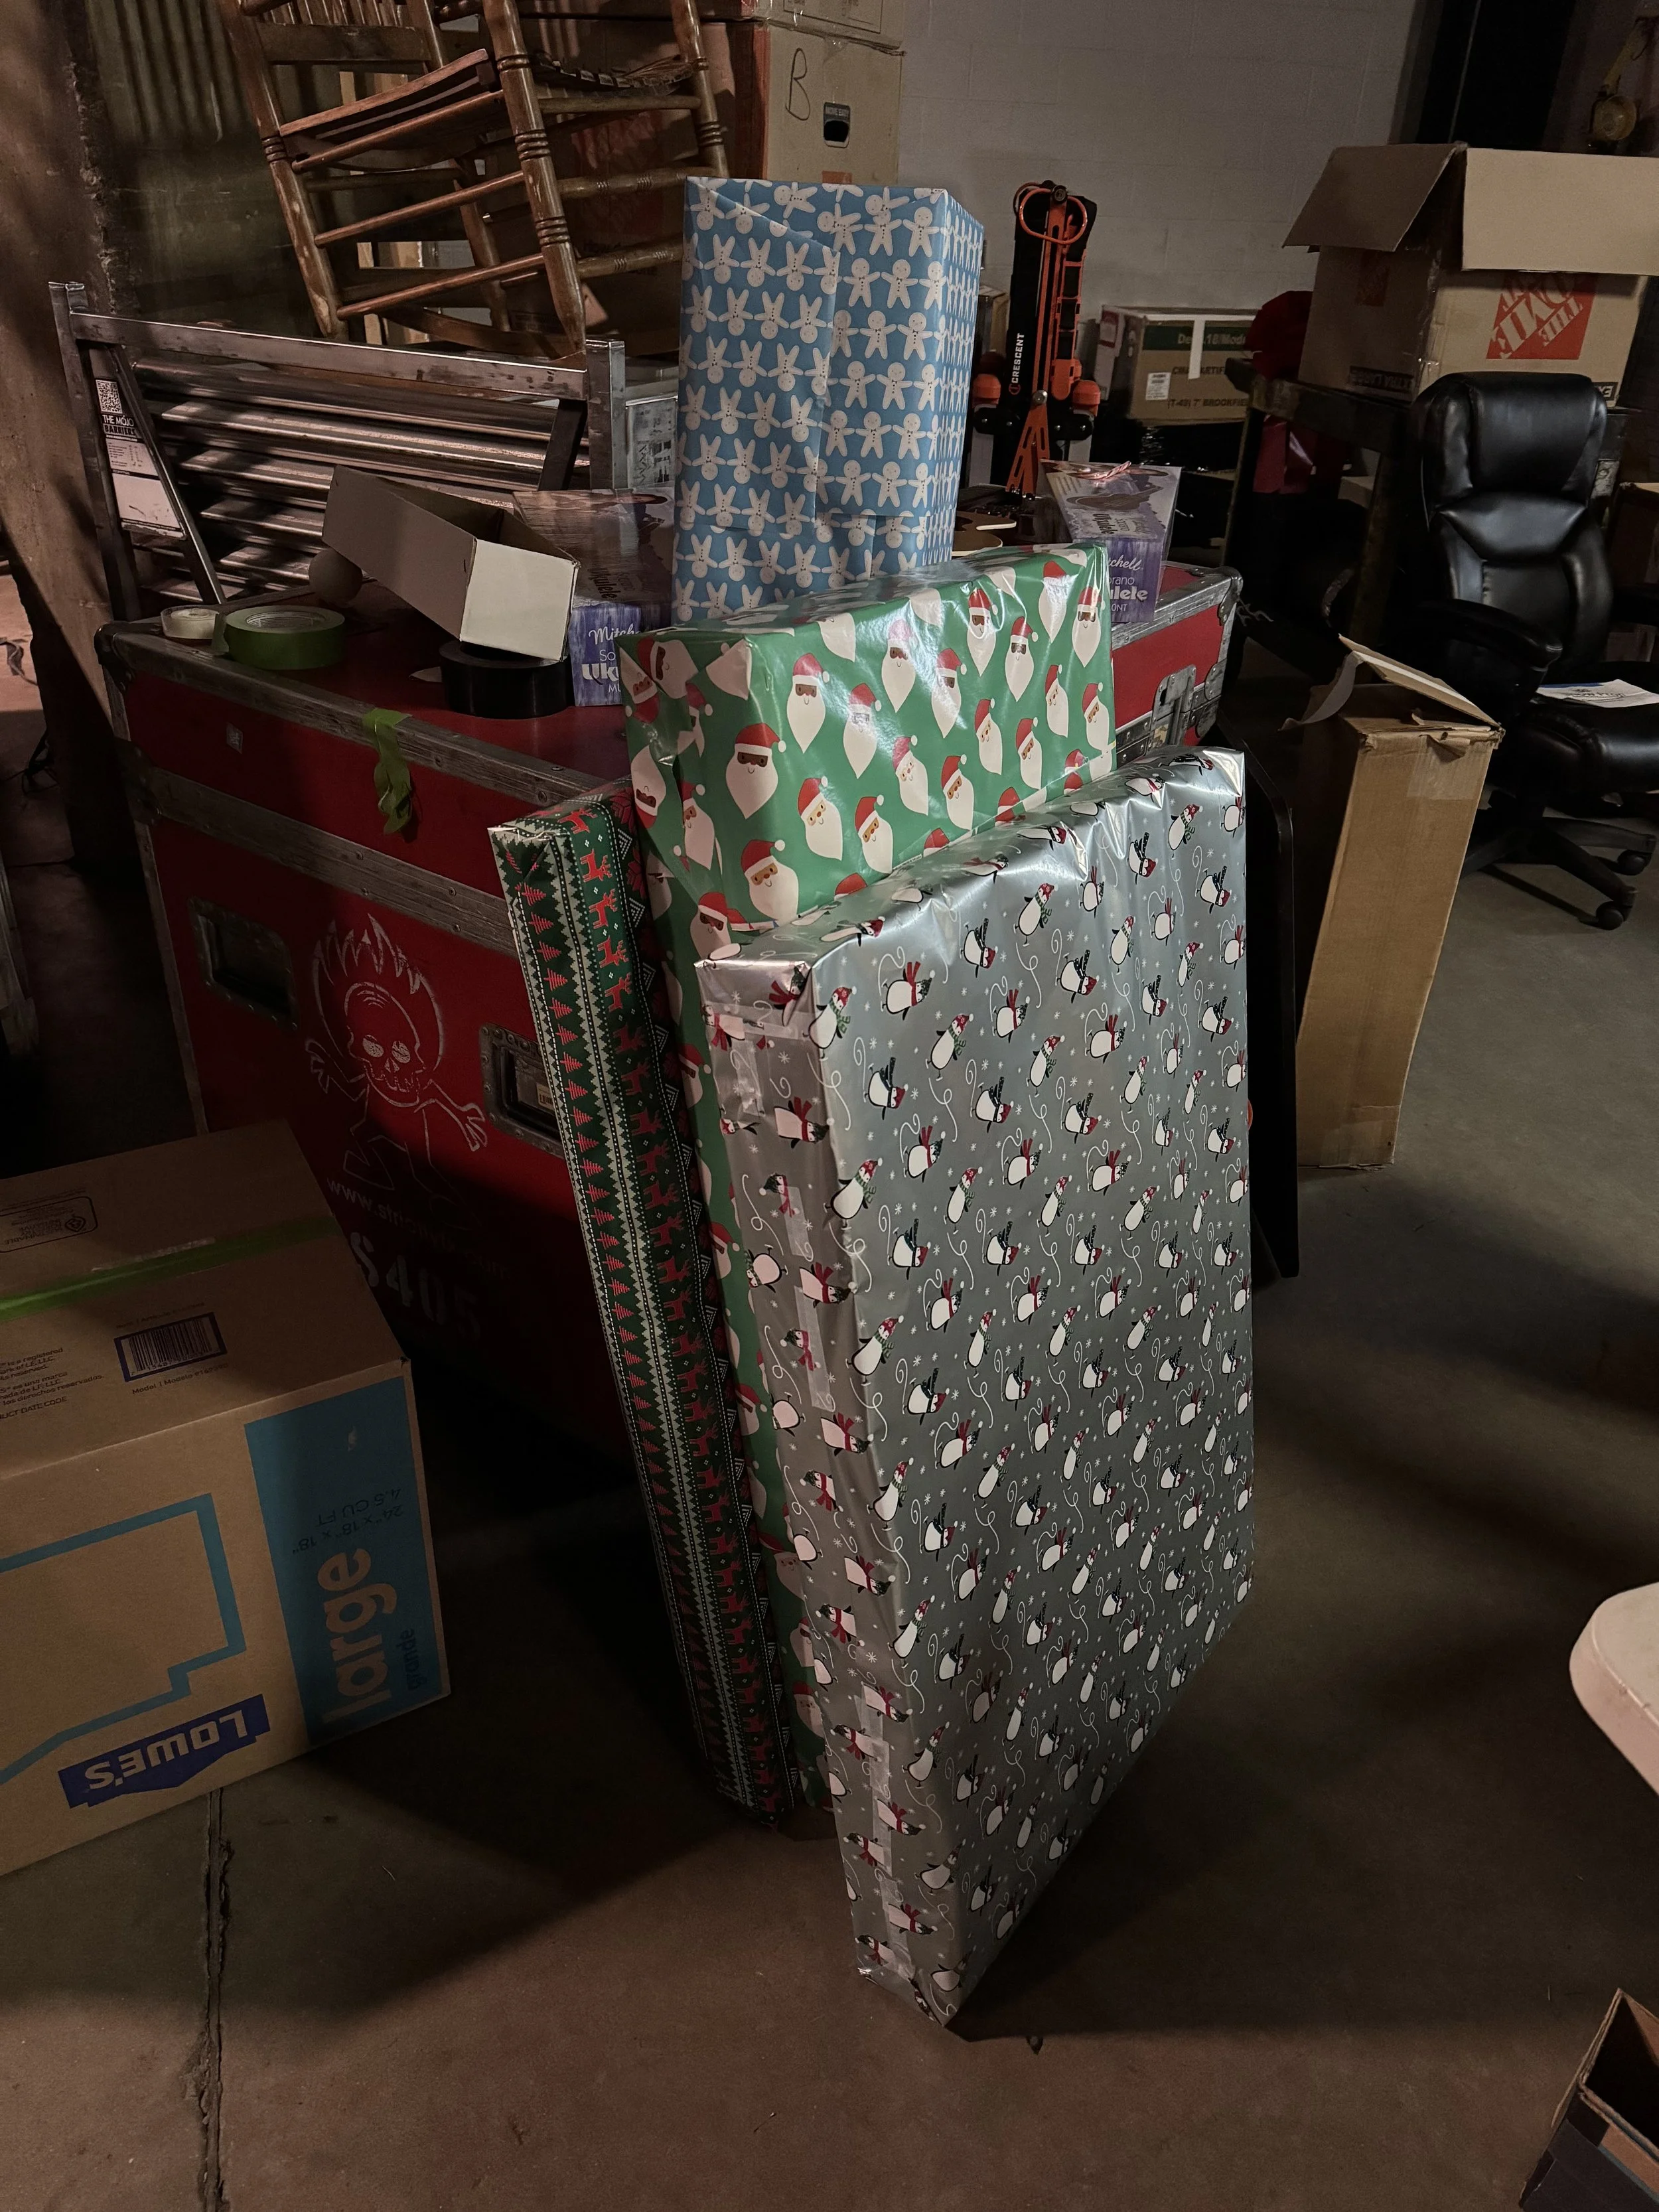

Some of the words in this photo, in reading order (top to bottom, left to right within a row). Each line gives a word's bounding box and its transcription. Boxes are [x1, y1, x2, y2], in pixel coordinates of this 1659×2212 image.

[785, 48, 811, 121] B
[1538, 296, 1585, 347] THE
[1011, 332, 1025, 384] CRESCENT
[102, 414, 115, 424] THE
[588, 623, 640, 645] Mitch
[23, 1348, 64, 1362] registered
[42, 1371, 68, 1382] marca
[132, 1383, 157, 1394] Model
[164, 1374, 193, 1386] Modelo
[17, 1387, 56, 1403] derechos
[57, 1374, 104, 1390] reservados.
[21, 1402, 43, 1414] DATE
[44, 1396, 68, 1408] CODE
[373, 1488, 402, 1507] 4.5
[315, 1510, 336, 1528] FT
[342, 1499, 370, 1518] CU
[317, 1547, 398, 1724] large
[397, 1628, 424, 1690] grande
[84, 1709, 248, 1790] LOWE'S
